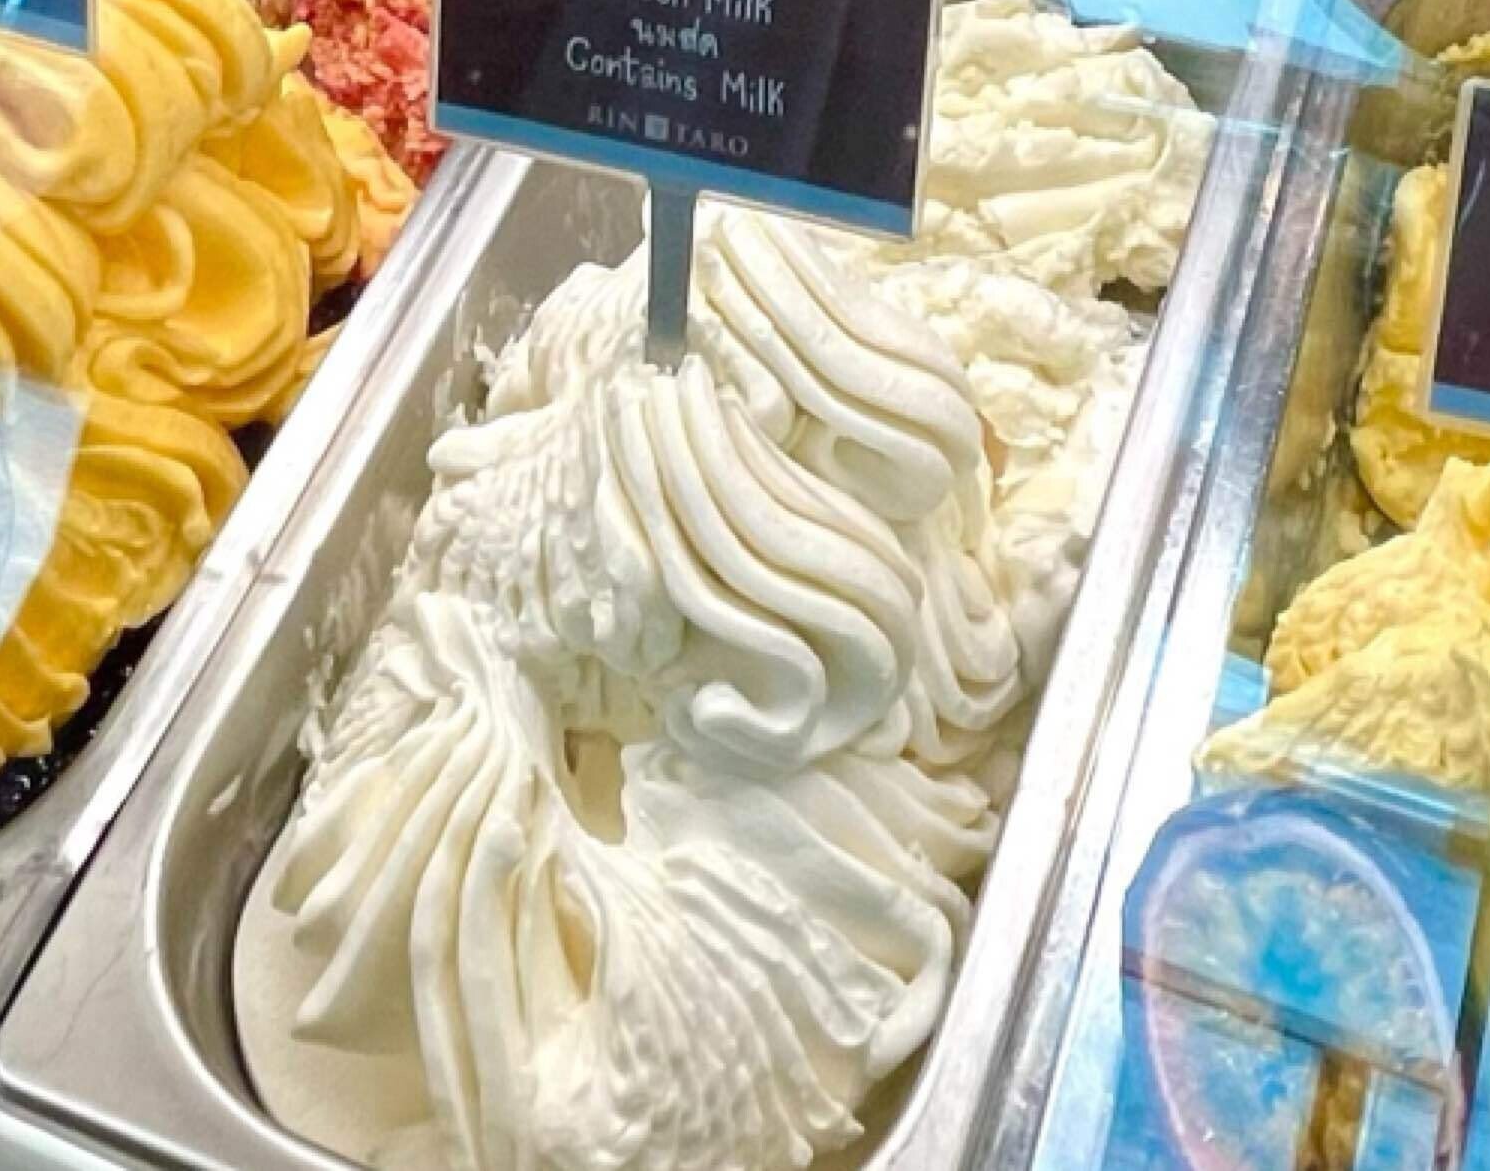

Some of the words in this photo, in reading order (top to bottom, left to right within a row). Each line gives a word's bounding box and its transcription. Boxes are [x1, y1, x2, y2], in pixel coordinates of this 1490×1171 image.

[566, 36, 698, 102] Contains
[588, 106, 638, 133] RIN
[673, 118, 749, 158] TARO
